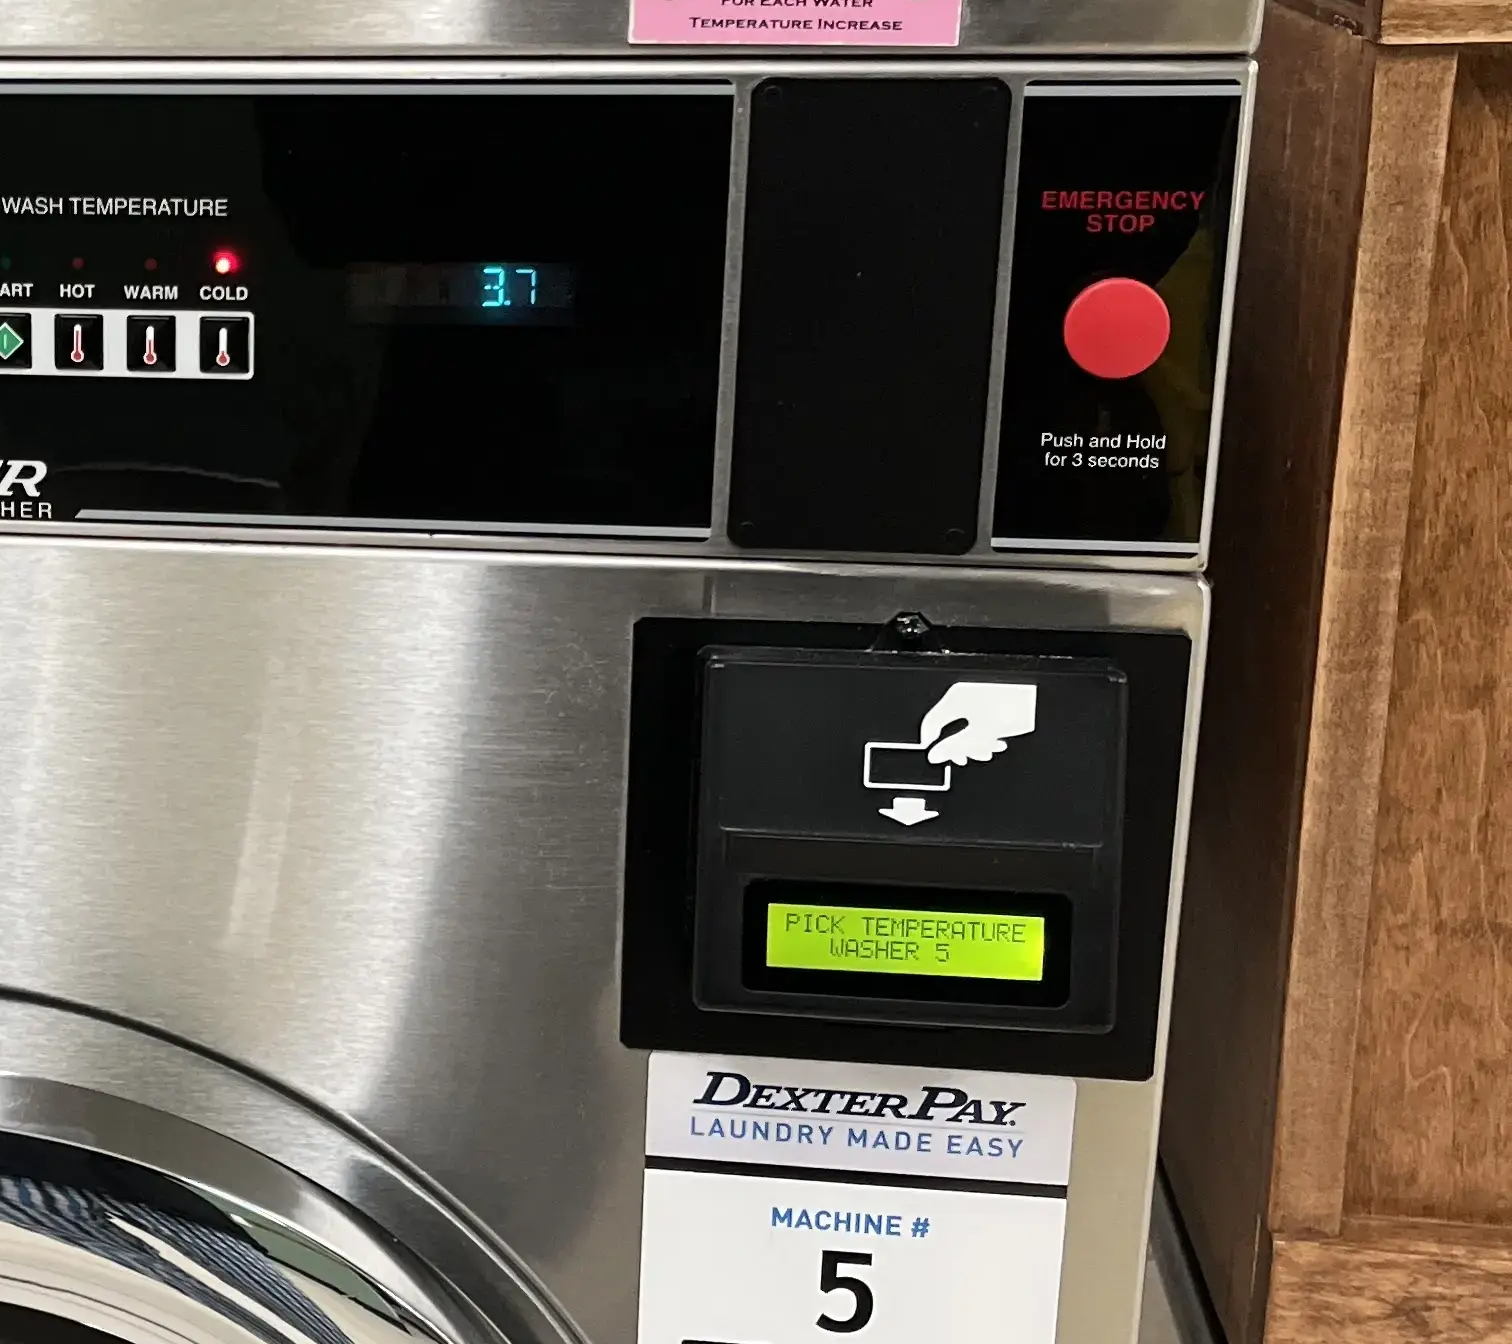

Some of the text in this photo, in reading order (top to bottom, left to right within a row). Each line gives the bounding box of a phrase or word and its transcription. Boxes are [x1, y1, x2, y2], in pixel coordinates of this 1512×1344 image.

[2, 197, 228, 216] WASH TEMPERATURE
[1042, 191, 1205, 210] EMERGENCY
[1087, 214, 1155, 233] STOP
[60, 284, 95, 298] HOT
[124, 285, 178, 300] WARM
[200, 286, 248, 300] COLD
[1041, 433, 1166, 449] Push and Hold
[1045, 452, 1159, 468] for 3 seconds
[786, 913, 1027, 943] PICK TEMPERATURE
[830, 939, 950, 962] WASHER 5
[691, 1116, 1023, 1159] LAUNDRY MADE EASY
[771, 1207, 930, 1238] MACHINE #
[816, 1249, 874, 1334] 5
